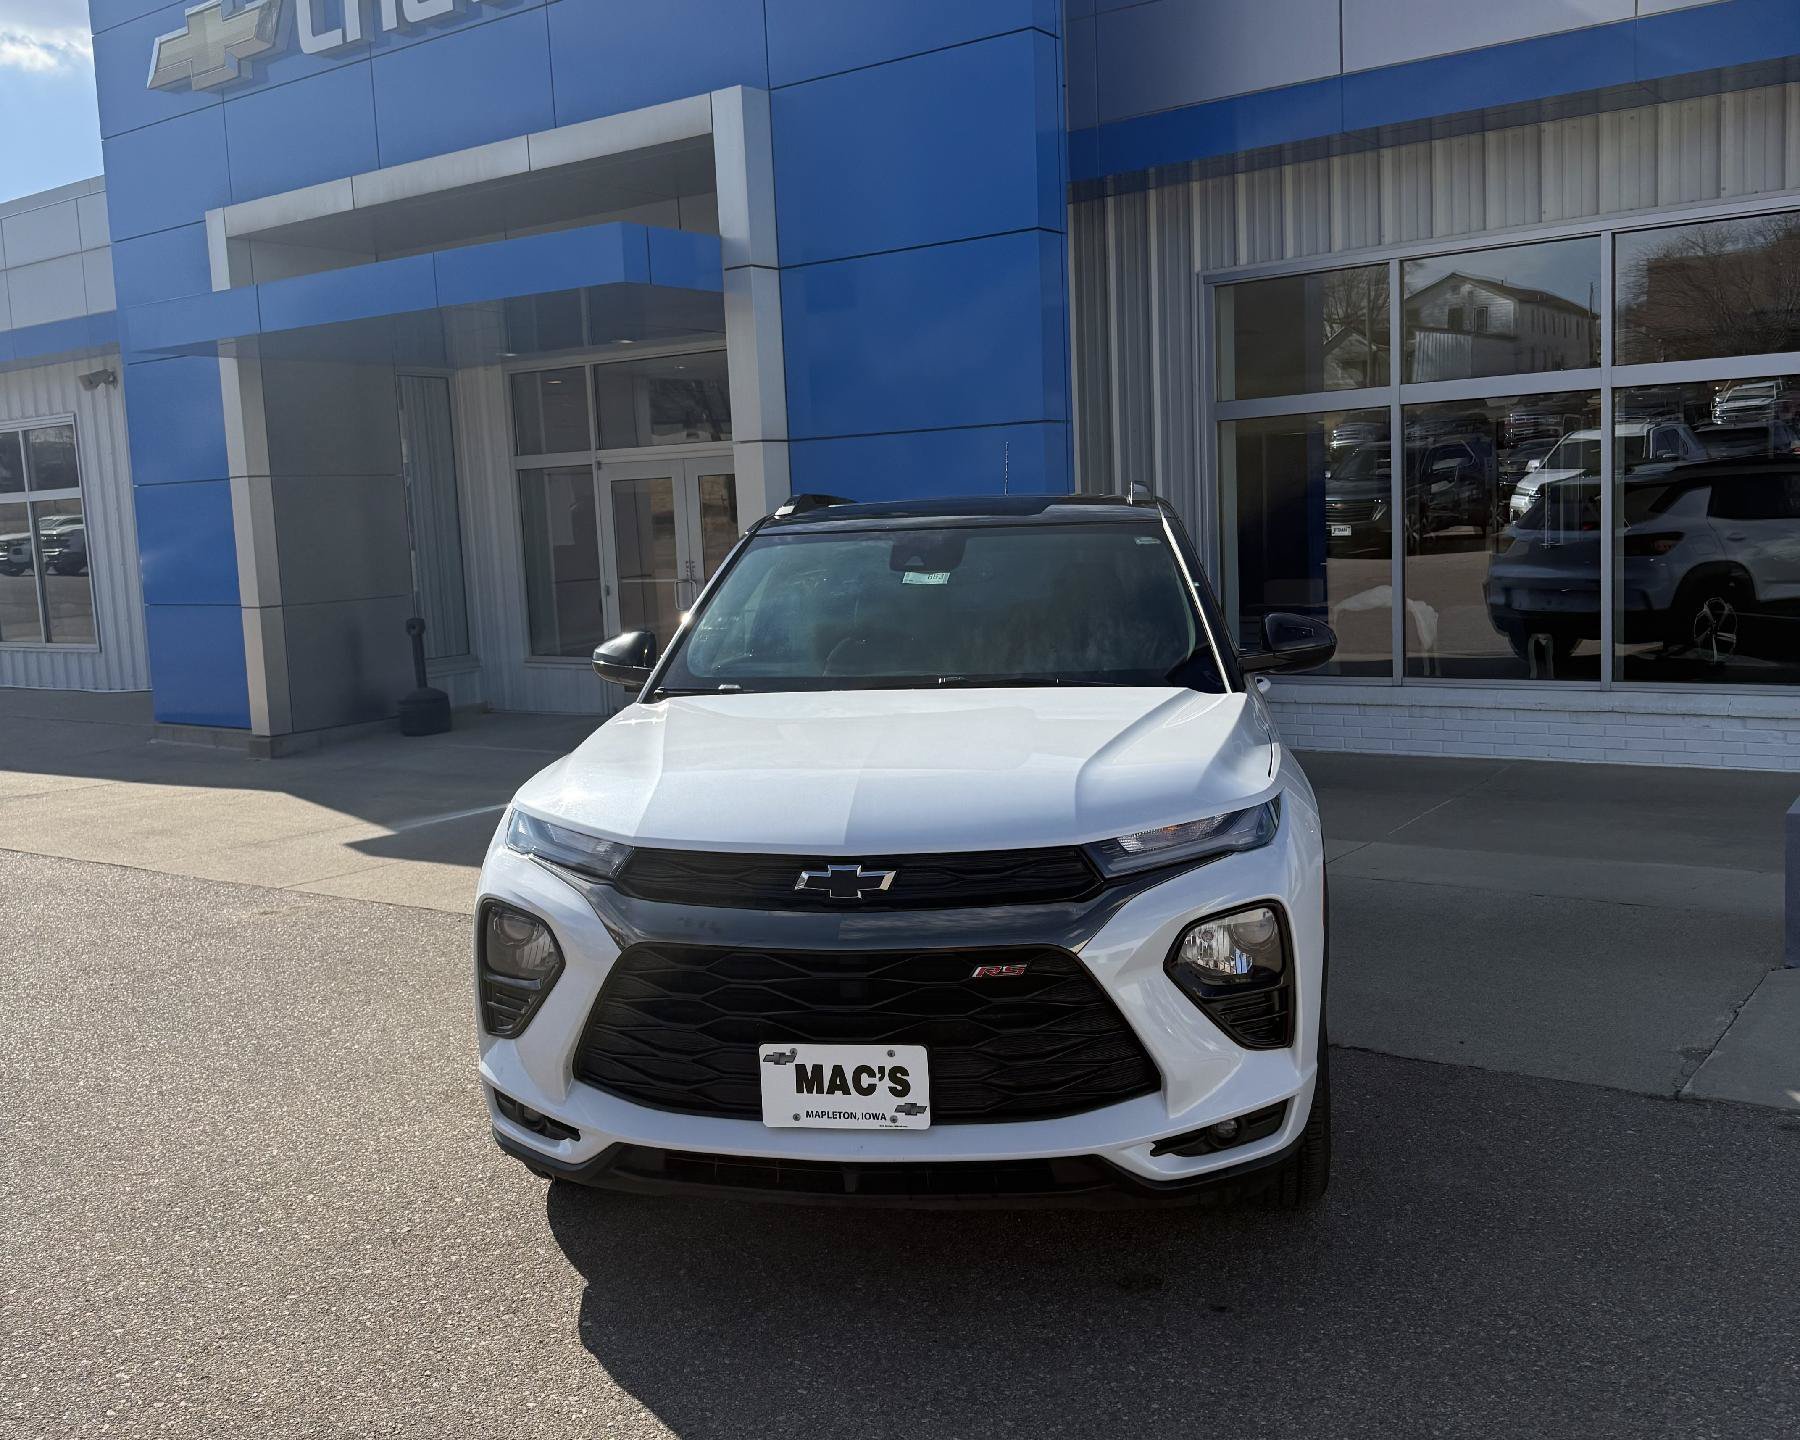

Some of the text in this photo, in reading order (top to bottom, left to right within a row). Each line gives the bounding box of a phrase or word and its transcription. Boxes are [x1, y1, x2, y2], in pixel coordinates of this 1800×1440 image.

[971, 964, 1027, 977] RS
[795, 1064, 911, 1098] MAC'S
[805, 1110, 887, 1121] MAPLETON, IOWA
